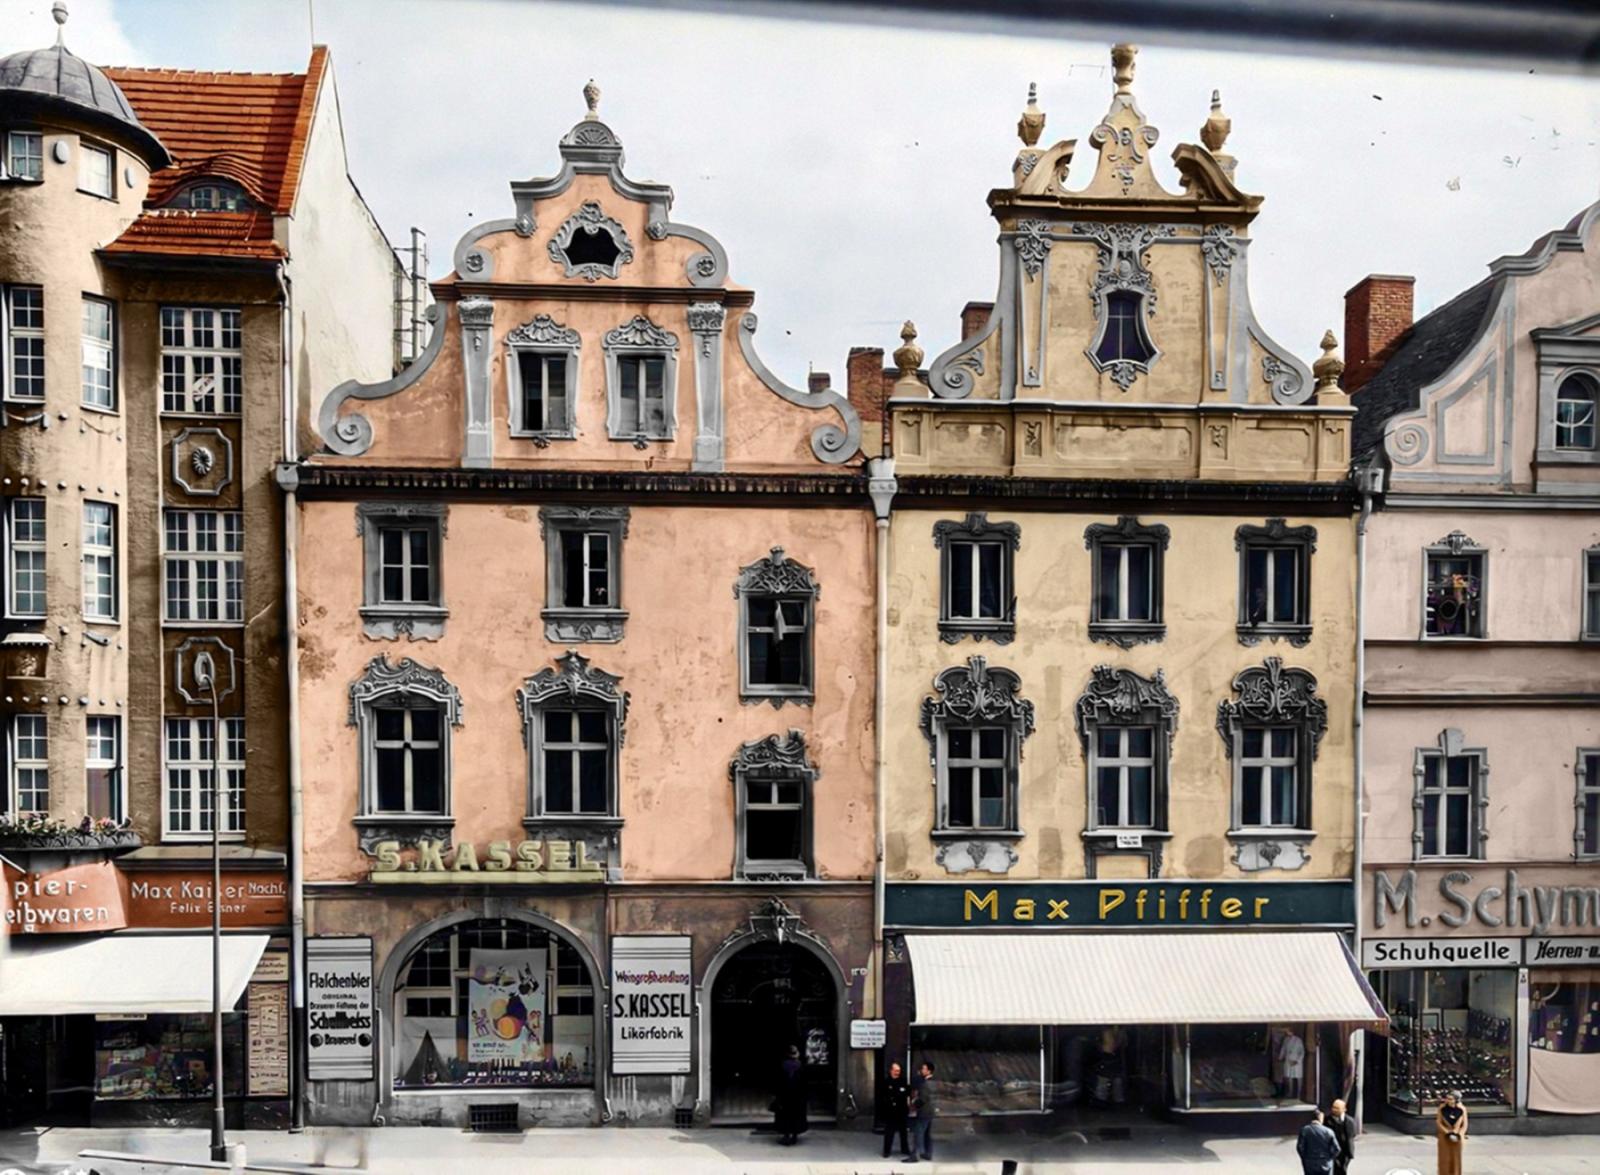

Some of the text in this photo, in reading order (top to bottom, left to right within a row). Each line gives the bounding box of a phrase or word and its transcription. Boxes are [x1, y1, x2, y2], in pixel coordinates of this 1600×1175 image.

[373, 840, 601, 871] S.KASSEL
[131, 881, 173, 899] Max
[181, 881, 245, 899] Kaier
[170, 902, 247, 914] Felix Esner
[964, 889, 1269, 920] Max Pfiffer
[1374, 943, 1510, 962] Schuhquelle
[613, 993, 691, 1018] S.KASSEL
